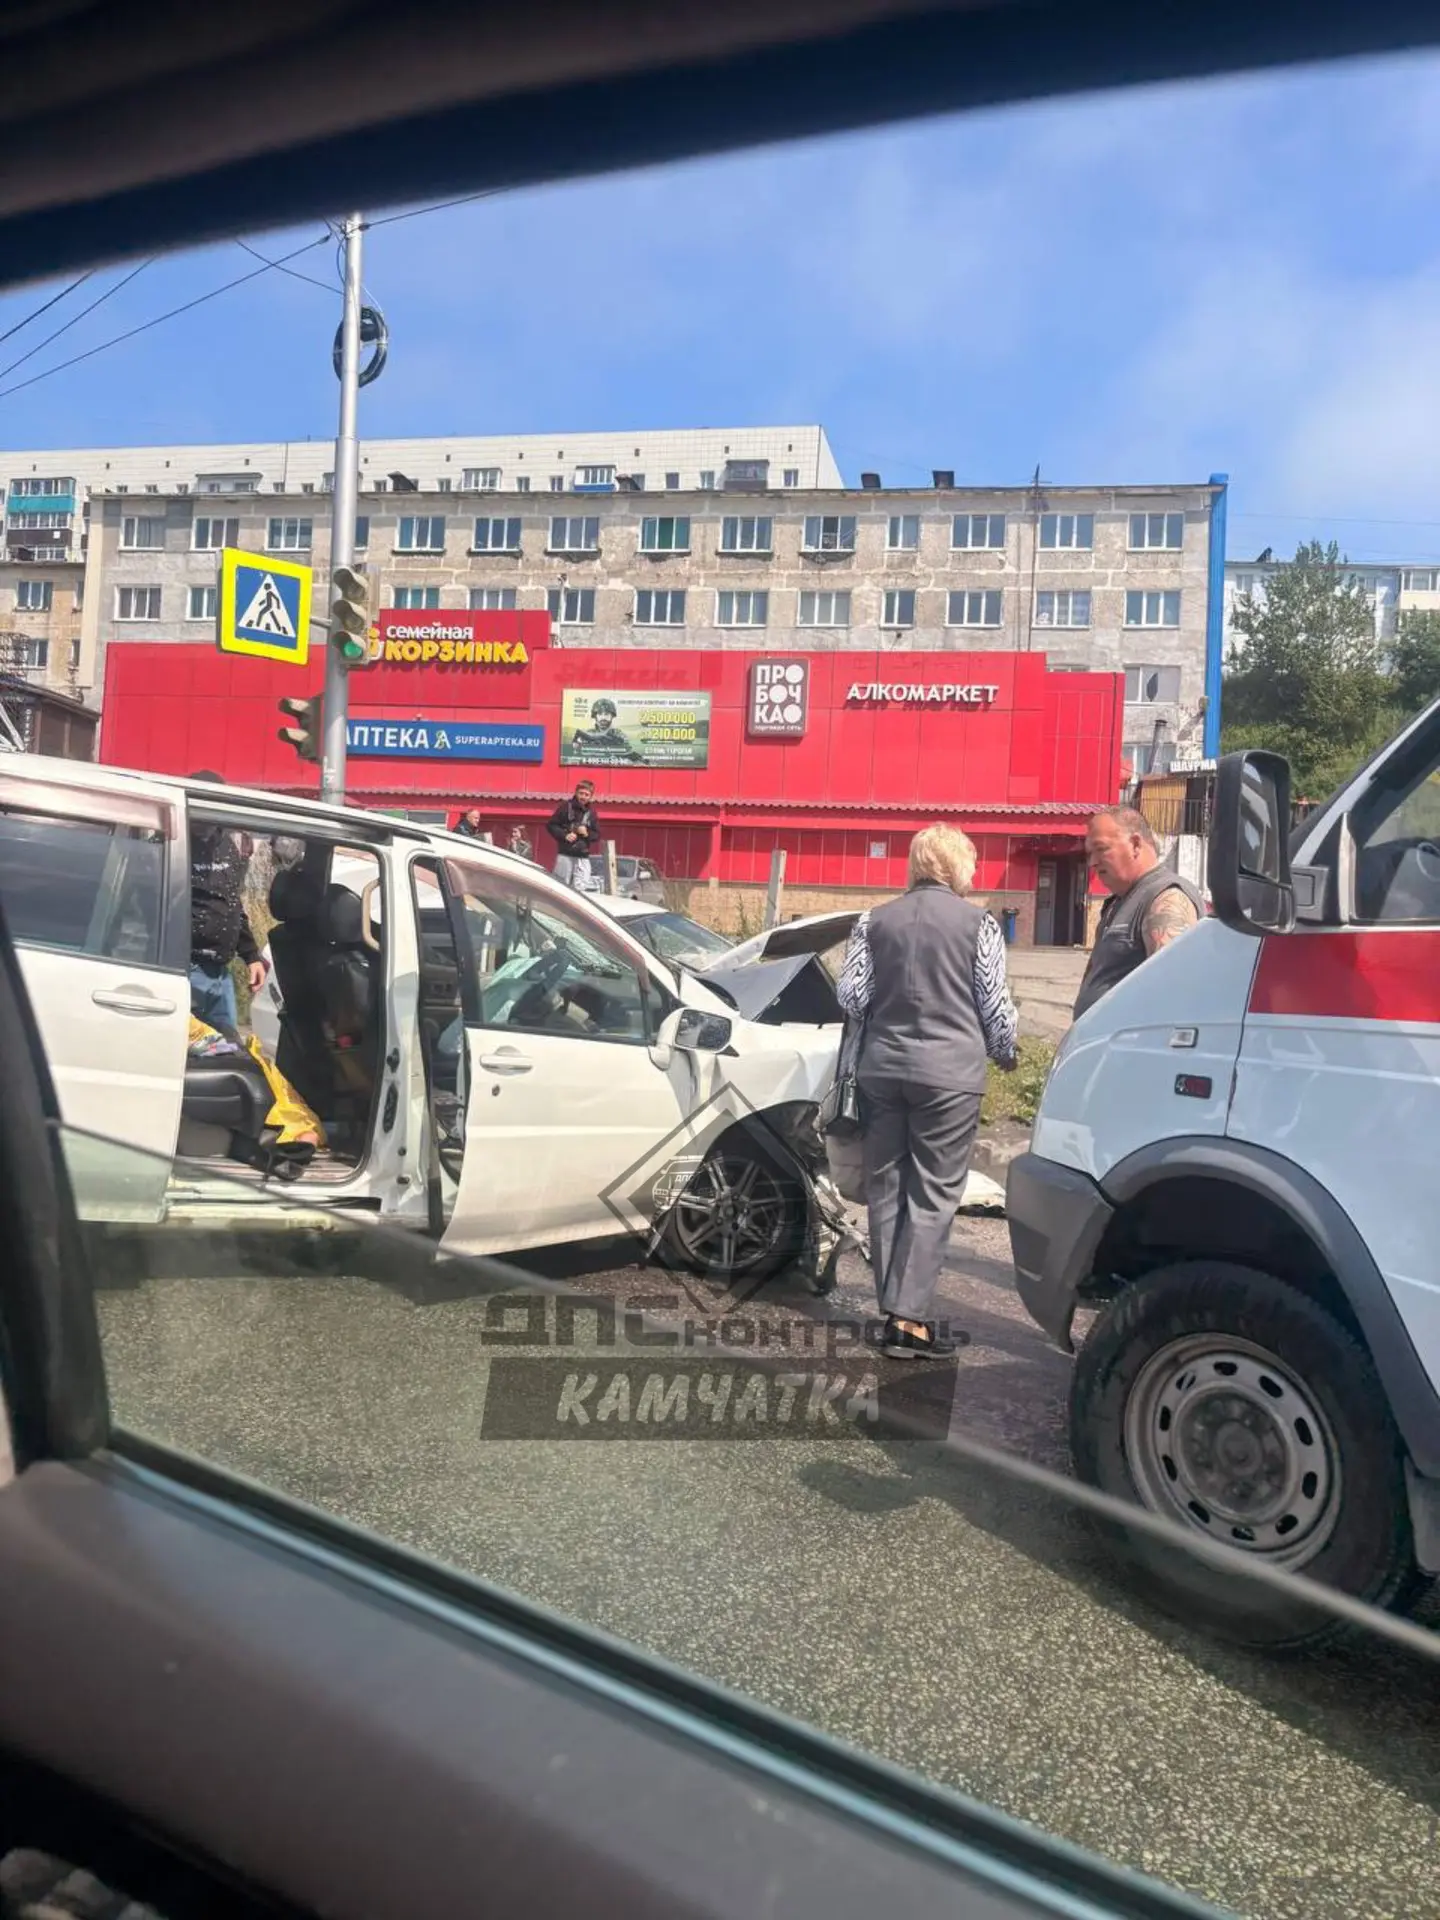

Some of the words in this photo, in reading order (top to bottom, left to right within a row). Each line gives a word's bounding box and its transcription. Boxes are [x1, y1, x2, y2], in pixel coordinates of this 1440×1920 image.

[386, 621, 474, 640] семейная
[385, 639, 529, 664] КОРЗИНКА
[756, 664, 804, 684] ПРО
[755, 684, 802, 704] БОЧ
[846, 683, 998, 703] АЛКОМАРКЕТ
[754, 704, 802, 724] КАО
[345, 725, 430, 750] ПТЕКА
[455, 735, 540, 748] SUPERAPTEKA.RU
